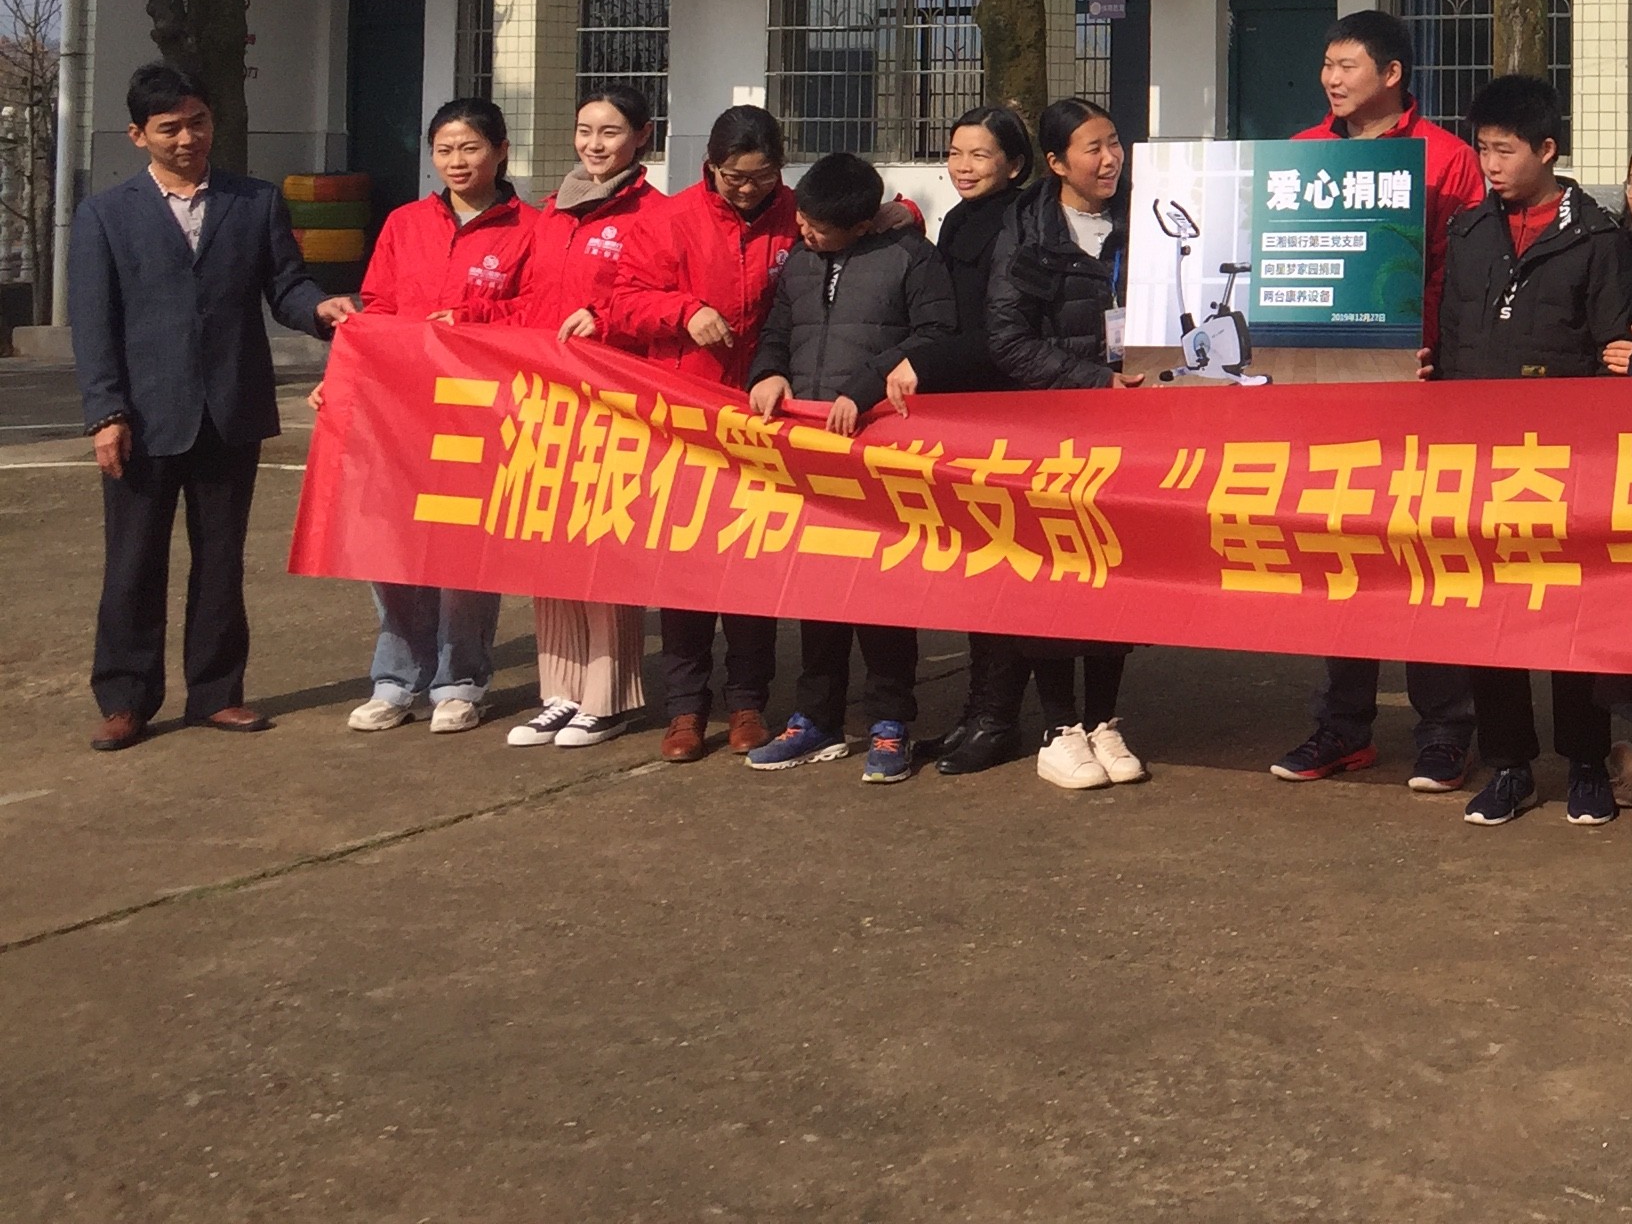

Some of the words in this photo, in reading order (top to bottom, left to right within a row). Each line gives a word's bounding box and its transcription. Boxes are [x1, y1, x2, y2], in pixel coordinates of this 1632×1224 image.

[1266, 168, 1412, 211] 爱心捐赠
[1265, 235, 1364, 248] 三湘银行第三党支部
[1264, 263, 1341, 275] 向星梦家园捐赠
[1263, 290, 1330, 302] 两台康养设备
